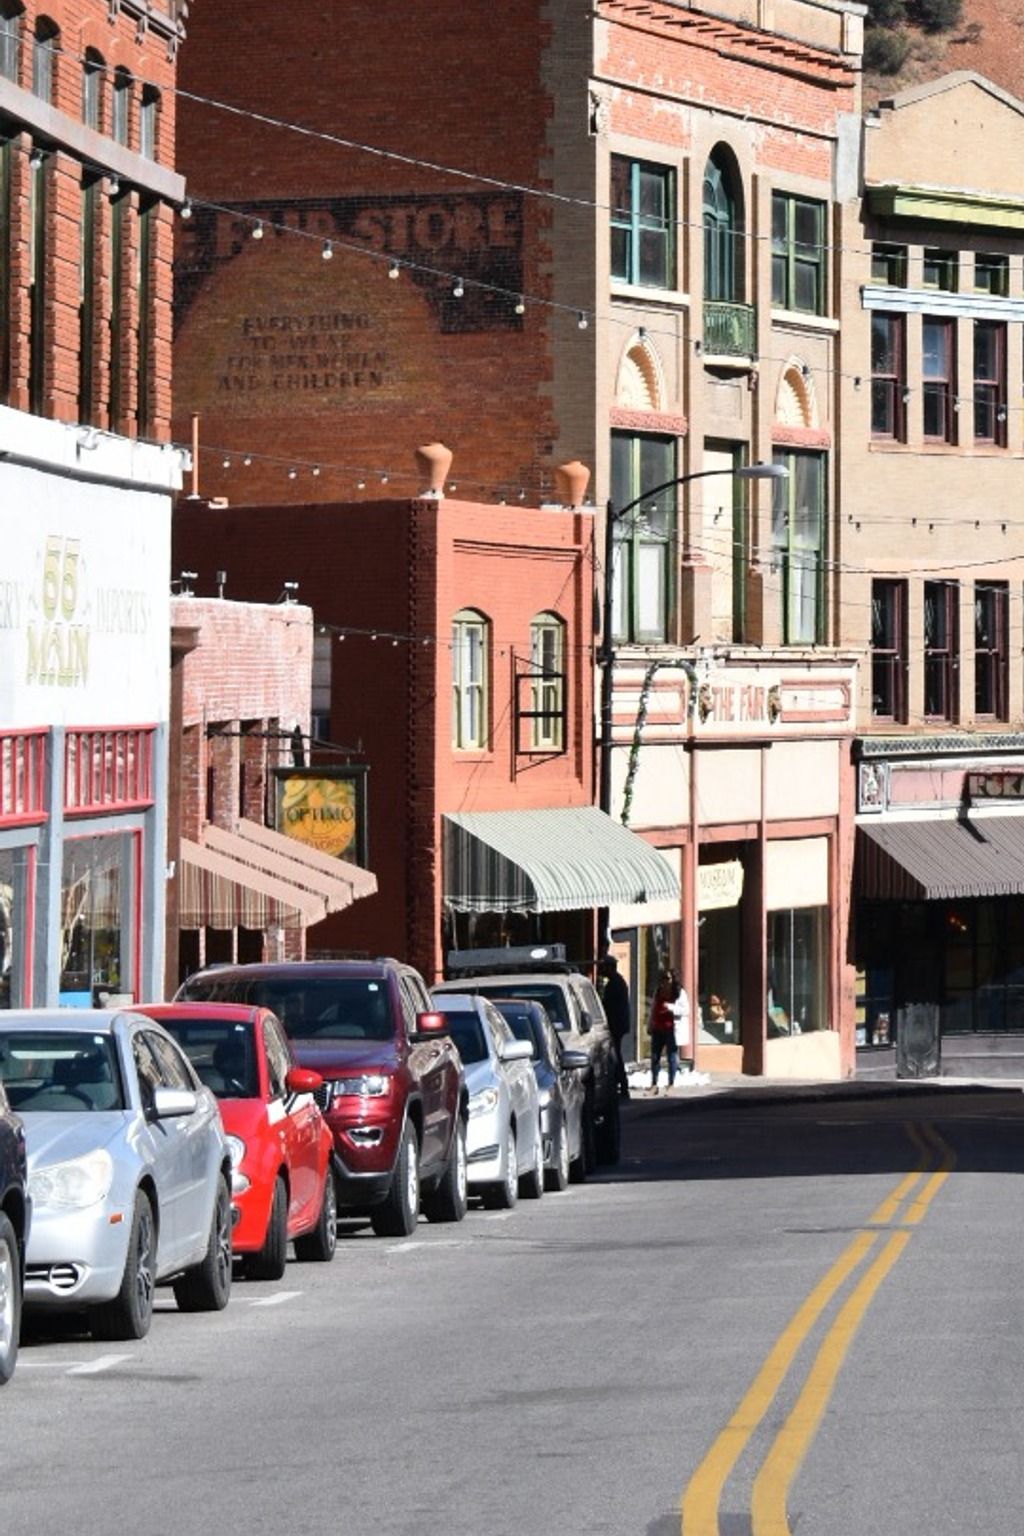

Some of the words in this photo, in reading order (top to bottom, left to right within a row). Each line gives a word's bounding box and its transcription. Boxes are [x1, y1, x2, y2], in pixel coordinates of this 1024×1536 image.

[353, 203, 517, 250] STORE
[242, 313, 371, 334] EVERYTHING
[250, 336, 276, 350] TO
[228, 354, 262, 369] FOR
[219, 375, 259, 391] AND
[26, 620, 90, 687] MAIN
[711, 686, 734, 721] THE
[740, 685, 765, 722] FAIR
[287, 807, 353, 824] OPTIMO
